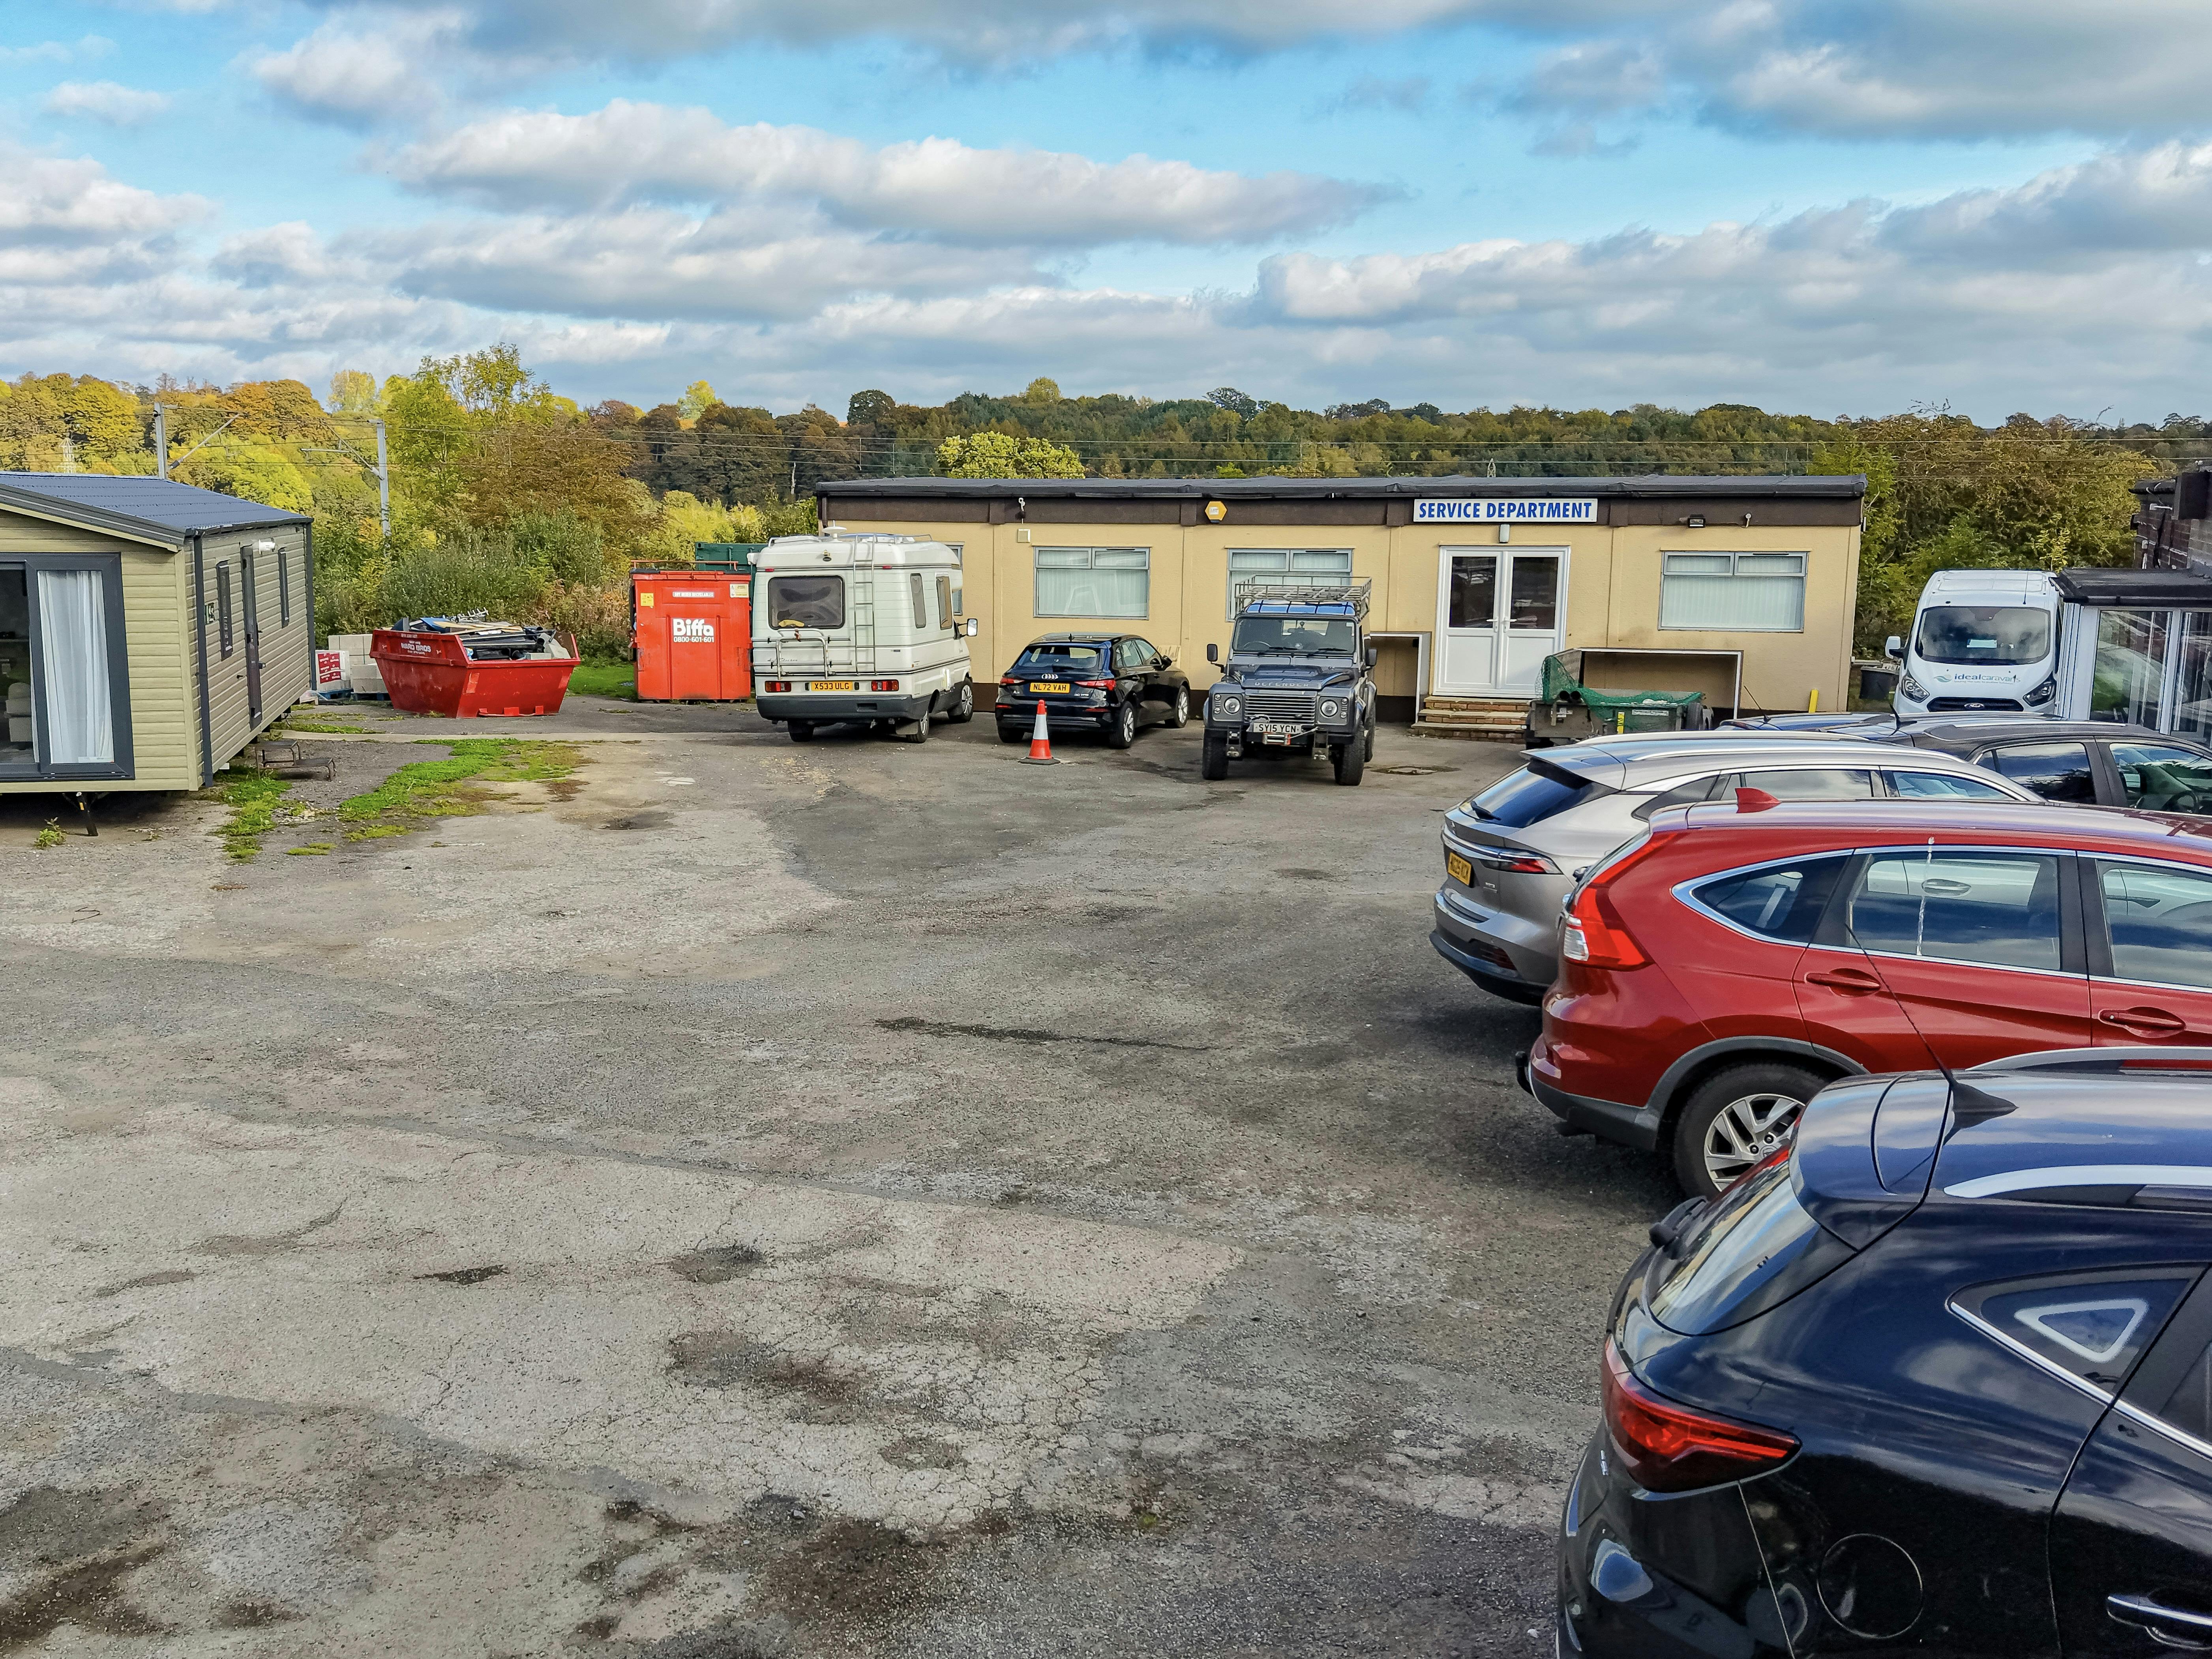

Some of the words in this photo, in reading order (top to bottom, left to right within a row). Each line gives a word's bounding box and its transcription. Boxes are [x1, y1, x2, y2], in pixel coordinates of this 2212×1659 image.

[1419, 502, 1480, 518] SERVICE
[1487, 502, 1592, 518] DEPARTMENT
[673, 619, 714, 636] Biffa
